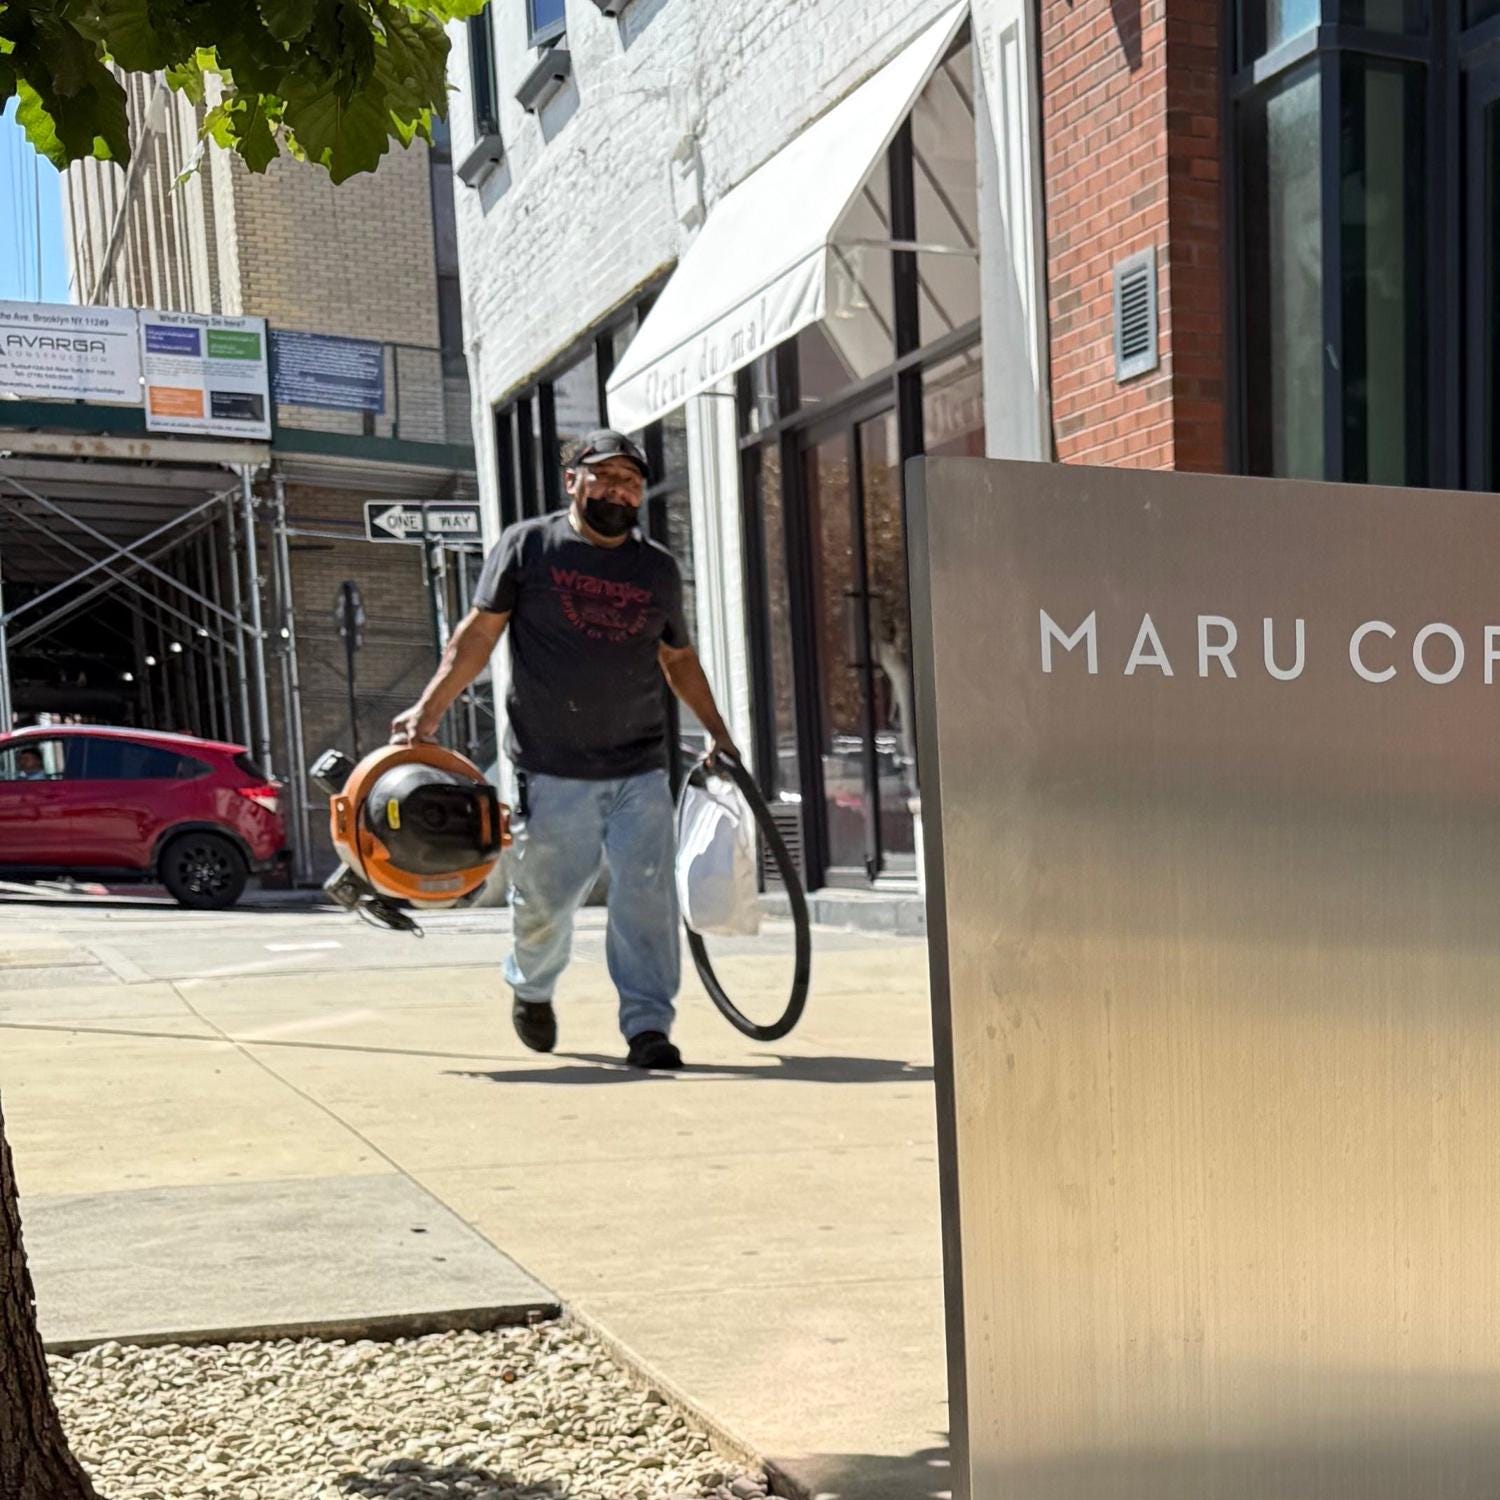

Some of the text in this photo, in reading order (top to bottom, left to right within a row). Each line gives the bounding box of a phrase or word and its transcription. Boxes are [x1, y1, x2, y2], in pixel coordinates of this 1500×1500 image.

[731, 297, 766, 362] mal
[7, 334, 106, 354] AVARGA
[7, 351, 108, 362] CONSTRUCTION
[386, 514, 471, 530] ONE WAY
[1039, 608, 1304, 681] MARU
